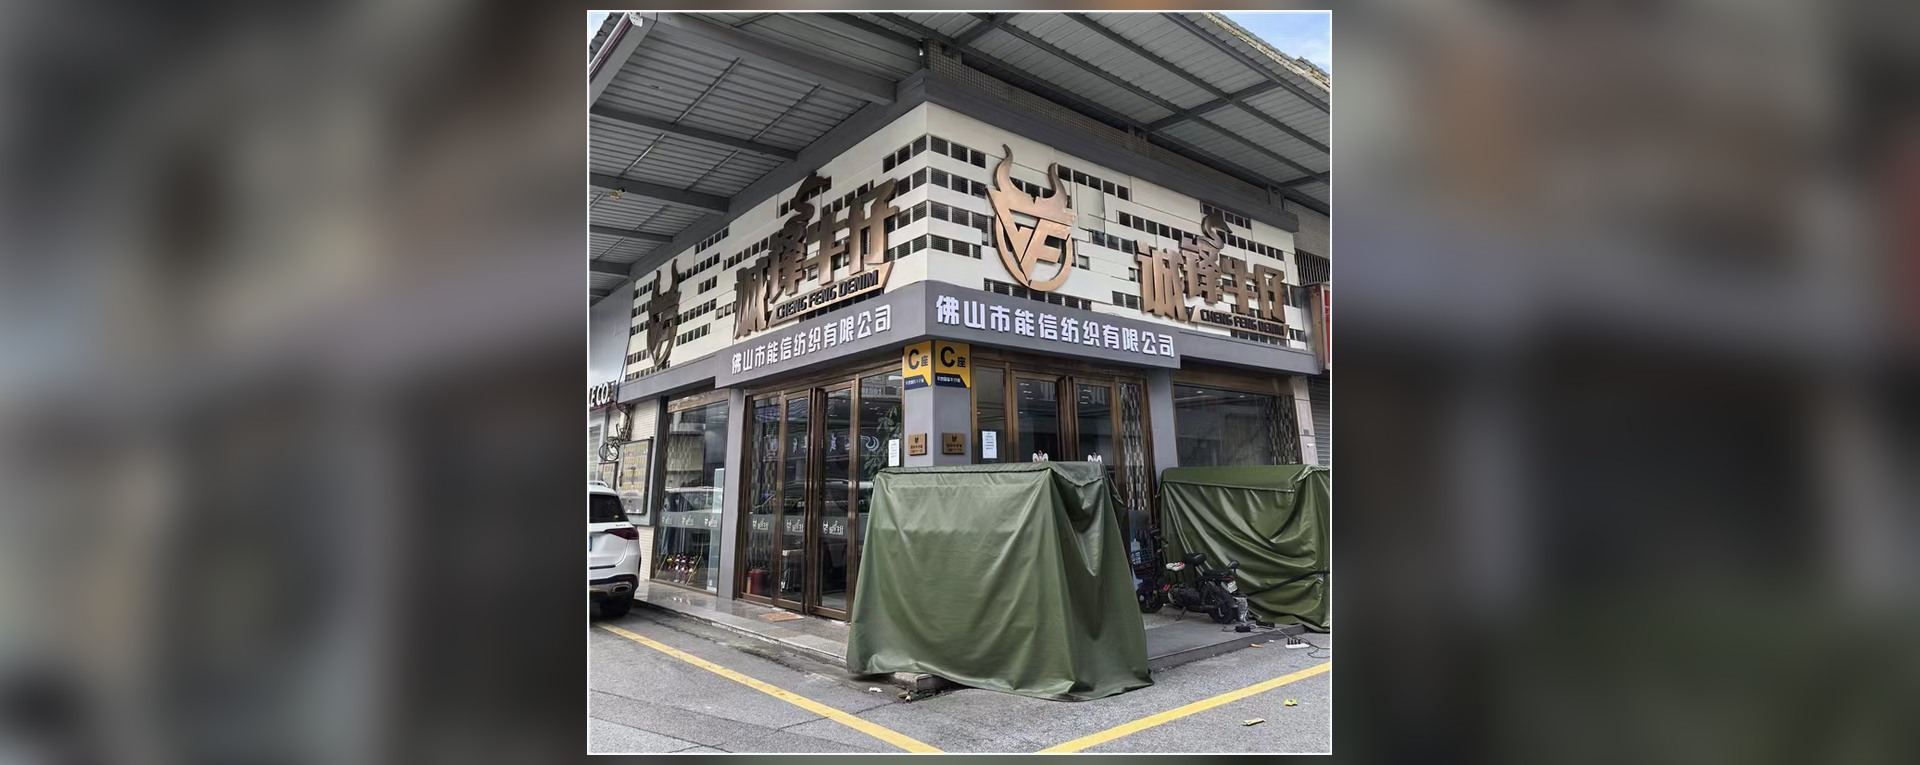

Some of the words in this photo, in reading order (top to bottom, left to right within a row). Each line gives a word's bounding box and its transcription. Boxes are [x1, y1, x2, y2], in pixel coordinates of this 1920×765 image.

[775, 295, 807, 320] CHENG
[808, 283, 837, 308] FENG
[838, 269, 878, 296] DENIM
[1200, 309, 1233, 327] CHENG
[731, 305, 891, 374] 佛山市能信纺织有限公司
[936, 294, 1175, 358] 佛山市能信纺织有限公司
